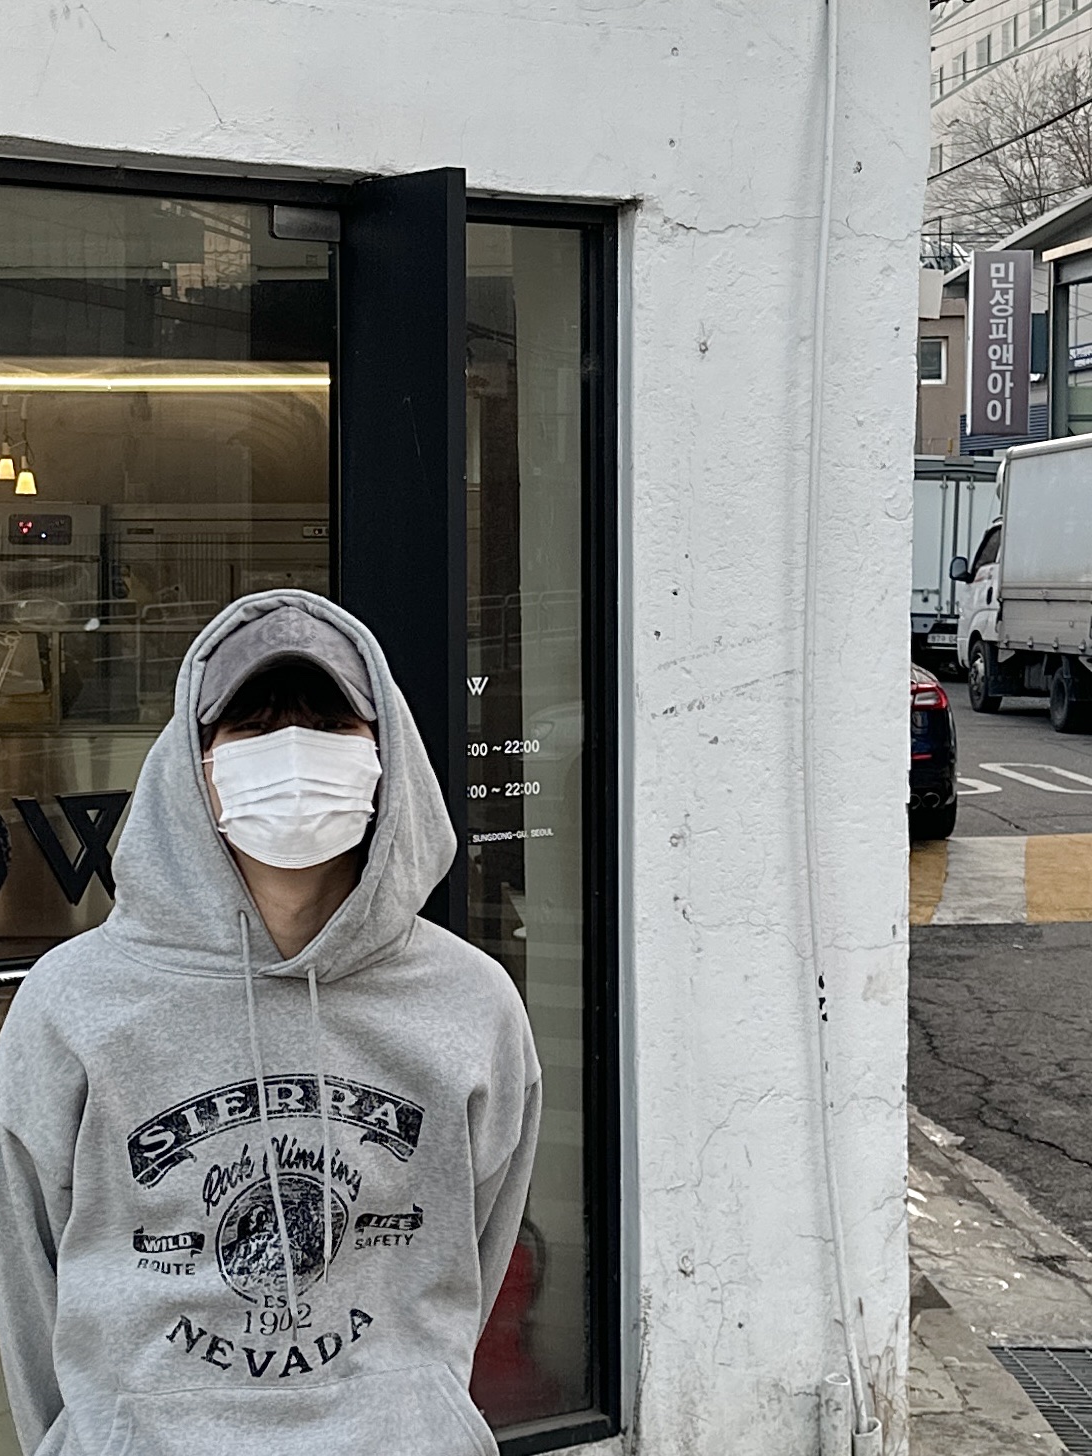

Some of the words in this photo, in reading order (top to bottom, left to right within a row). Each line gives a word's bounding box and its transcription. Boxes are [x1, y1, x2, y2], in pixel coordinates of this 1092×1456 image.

[985, 260, 1016, 427] 민성피앤아이
[467, 743, 488, 757] :00
[504, 740, 540, 754] 22:00
[467, 784, 488, 798] :00
[505, 782, 540, 797] 22:00
[530, 827, 554, 839] SEOUL
[138, 1082, 401, 1158] SIERRA
[368, 1215, 413, 1231] LIFE
[143, 1234, 192, 1252] WILD
[354, 1233, 414, 1251] SAFETY
[136, 1257, 196, 1276] ROUTE
[165, 1306, 375, 1379] NEVADA
